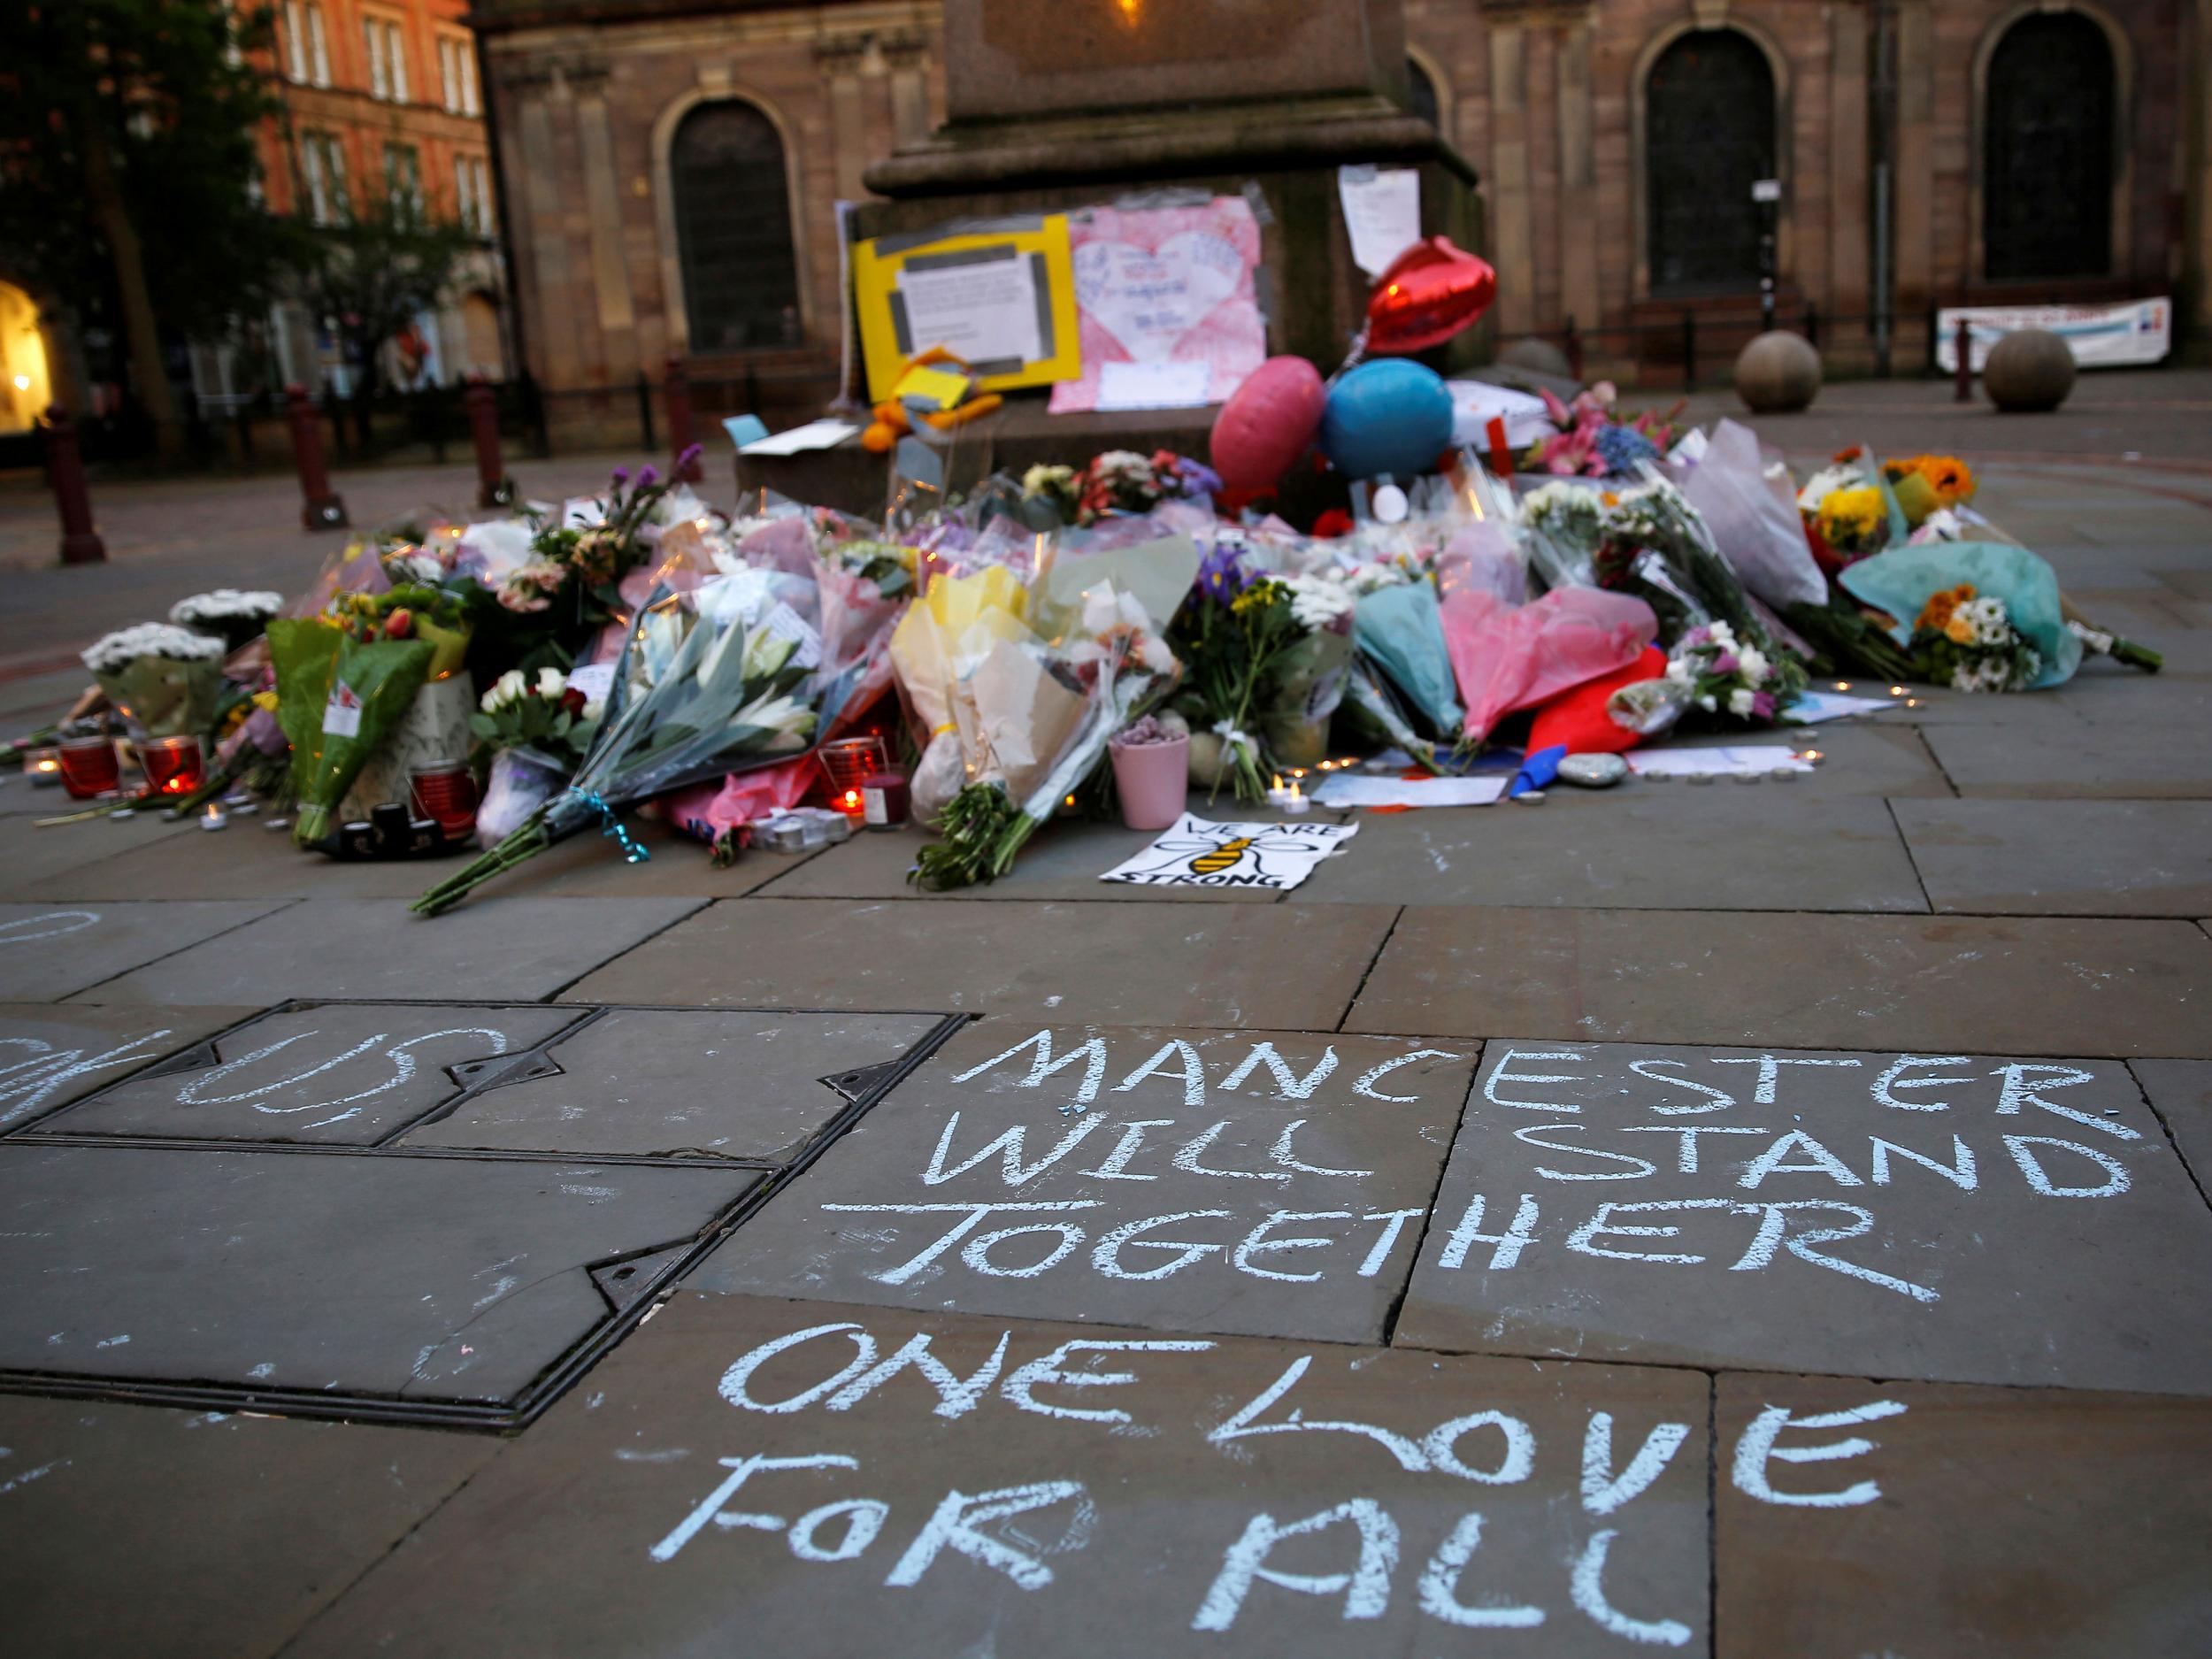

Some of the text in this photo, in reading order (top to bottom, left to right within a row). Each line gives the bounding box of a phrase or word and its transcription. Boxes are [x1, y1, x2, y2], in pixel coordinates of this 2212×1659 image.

[1187, 820, 1341, 837] WE ARE
[1118, 871, 1286, 887] STRONG
[919, 1110, 2133, 1198] WILL STAND
[820, 1193, 1942, 1302] TOGETHER
[717, 1322, 1909, 1516] ONE LOVE
[648, 1454, 1693, 1647] FOR ALL
